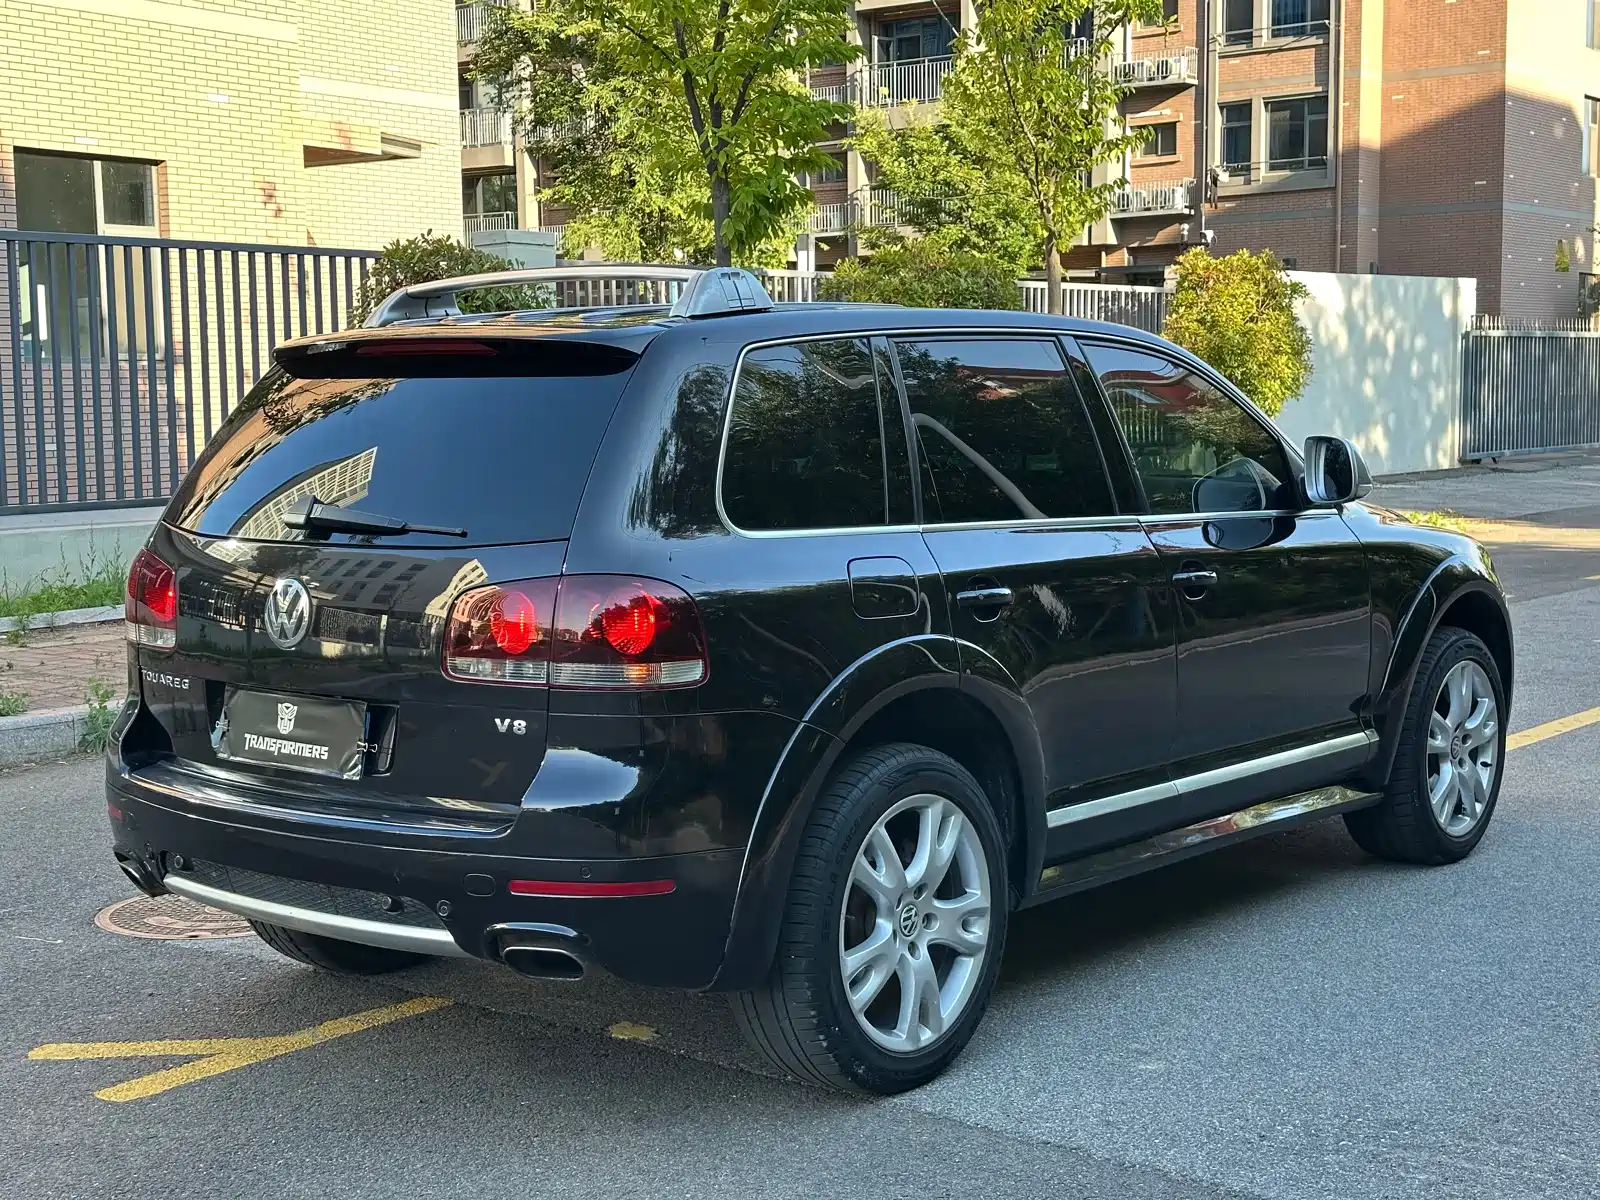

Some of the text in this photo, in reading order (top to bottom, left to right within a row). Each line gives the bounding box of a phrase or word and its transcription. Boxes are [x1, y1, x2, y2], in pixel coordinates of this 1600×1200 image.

[265, 578, 309, 648] VW
[141, 669, 190, 690] TOUAREG
[494, 718, 527, 735] V8
[244, 733, 329, 760] TRANSFORMERS
